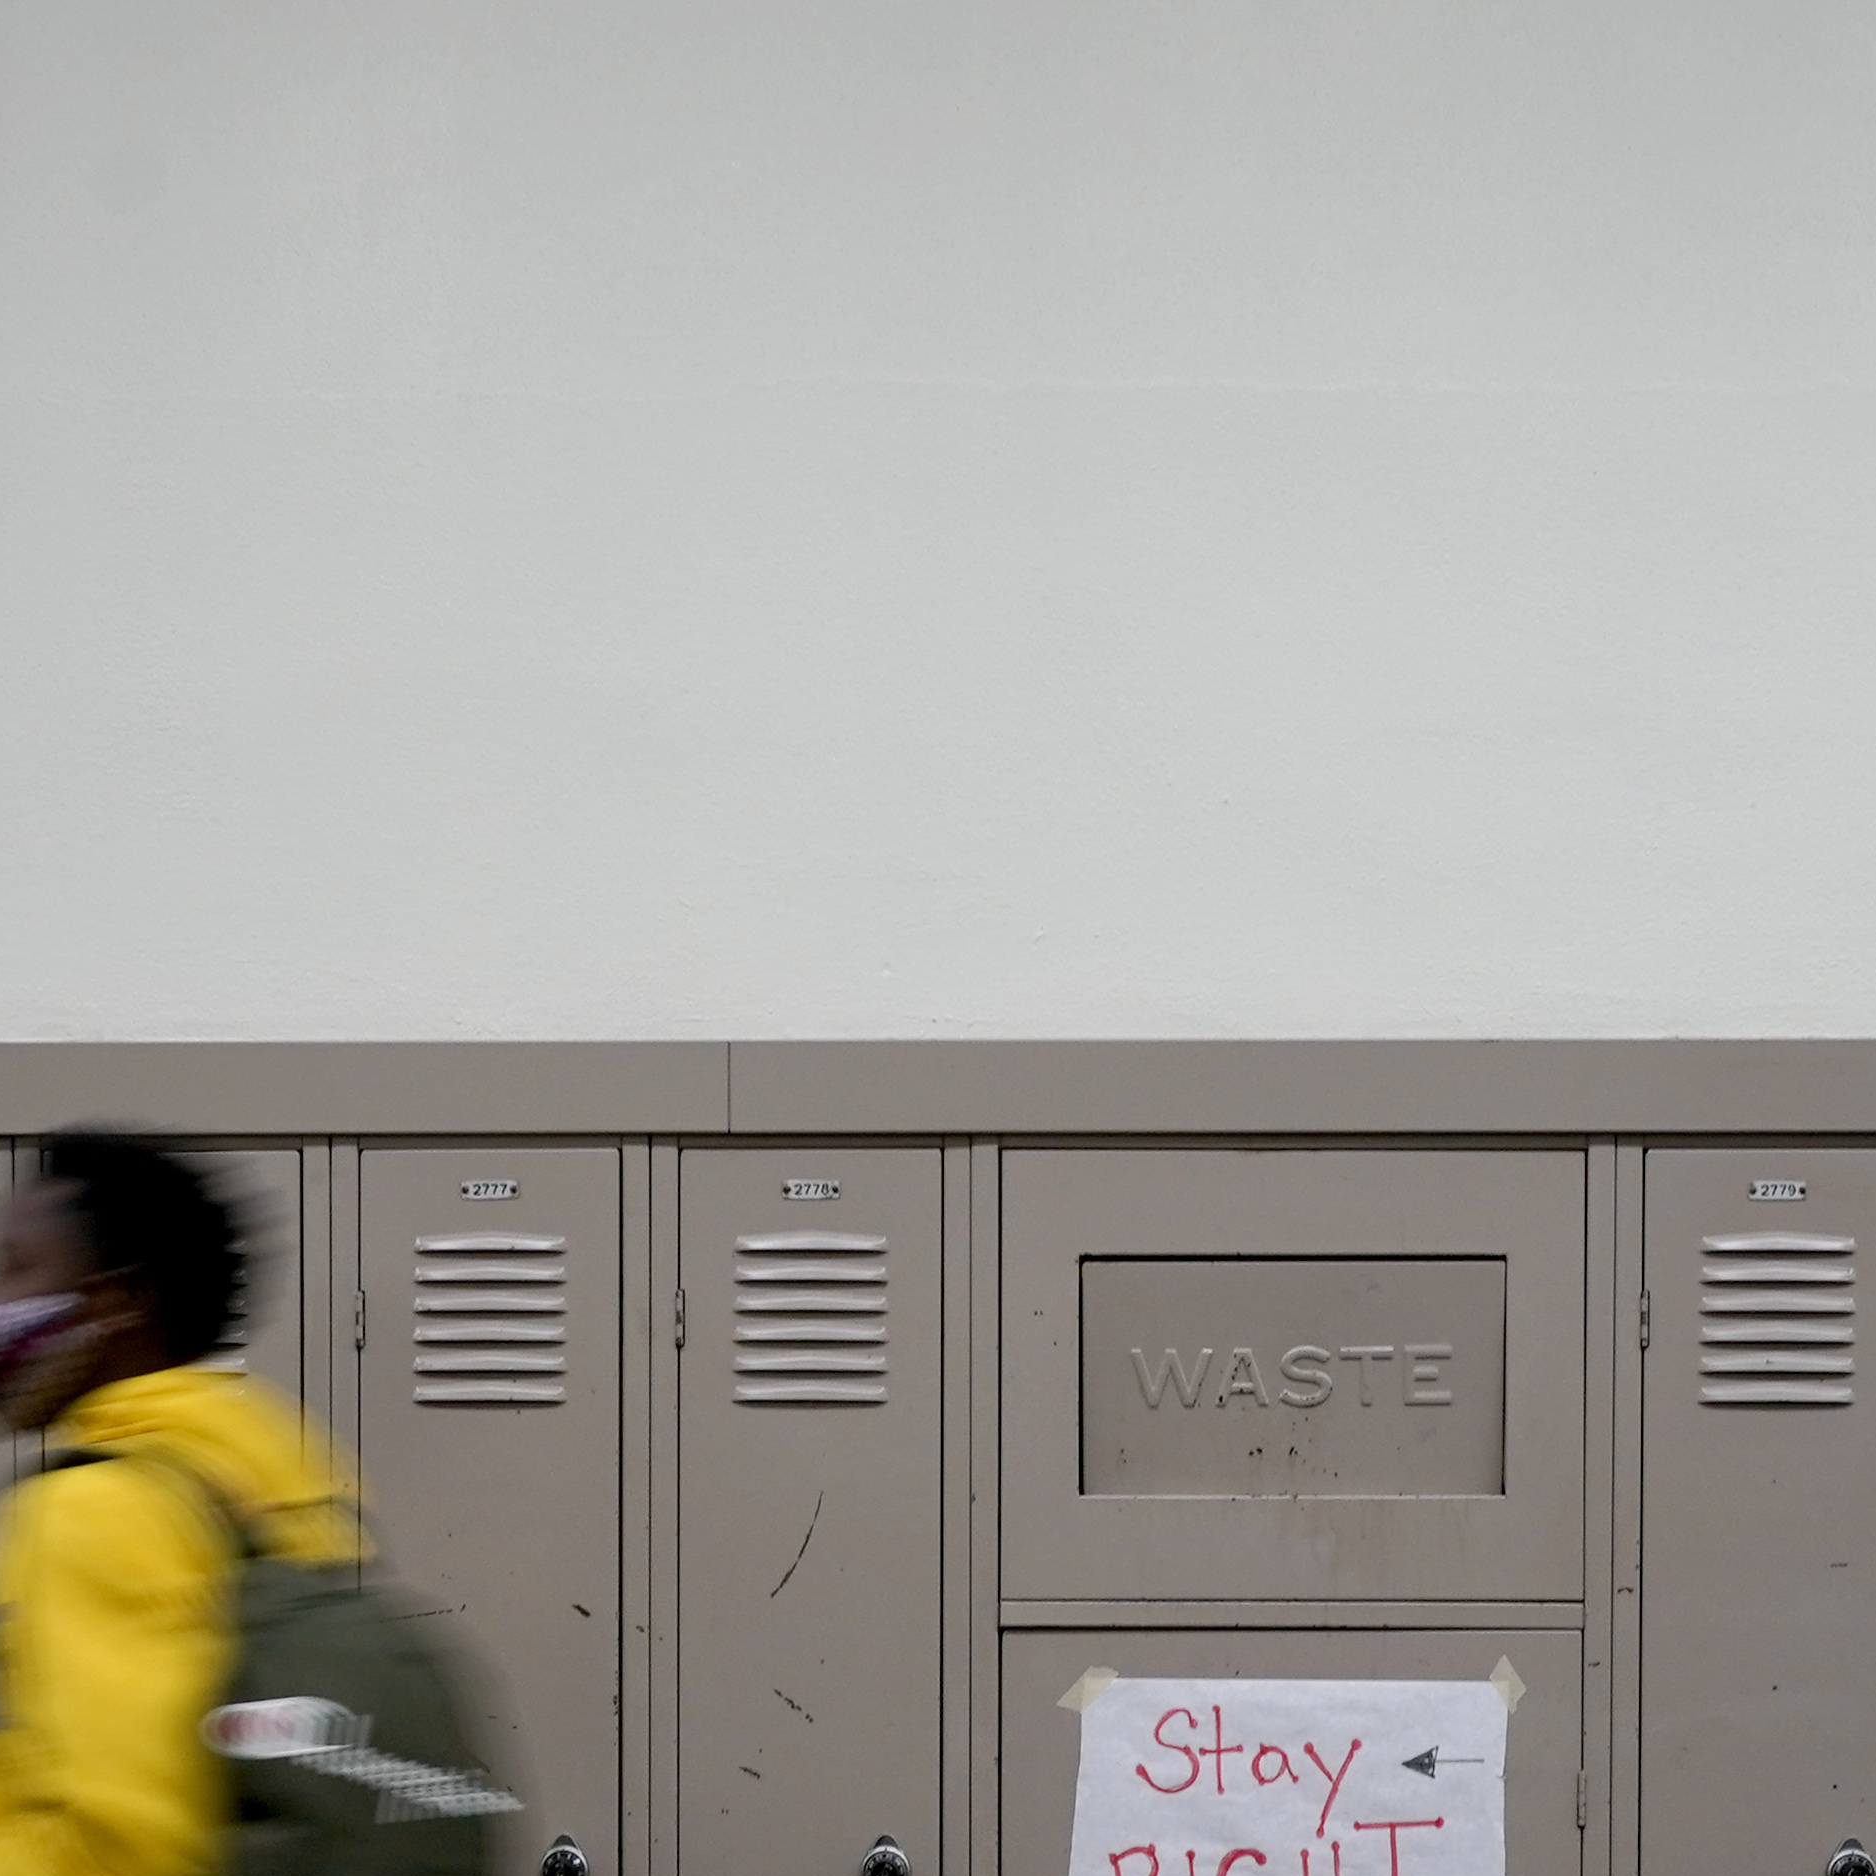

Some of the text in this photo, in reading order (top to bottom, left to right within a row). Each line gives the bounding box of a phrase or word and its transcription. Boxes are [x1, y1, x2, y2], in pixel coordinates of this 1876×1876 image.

[472, 1184, 508, 1196] 2777
[793, 1183, 829, 1195] 2778
[1760, 1185, 1797, 1197] 2779
[1129, 1344, 1454, 1409] WASTE
[1136, 1705, 1361, 1838] Stay
